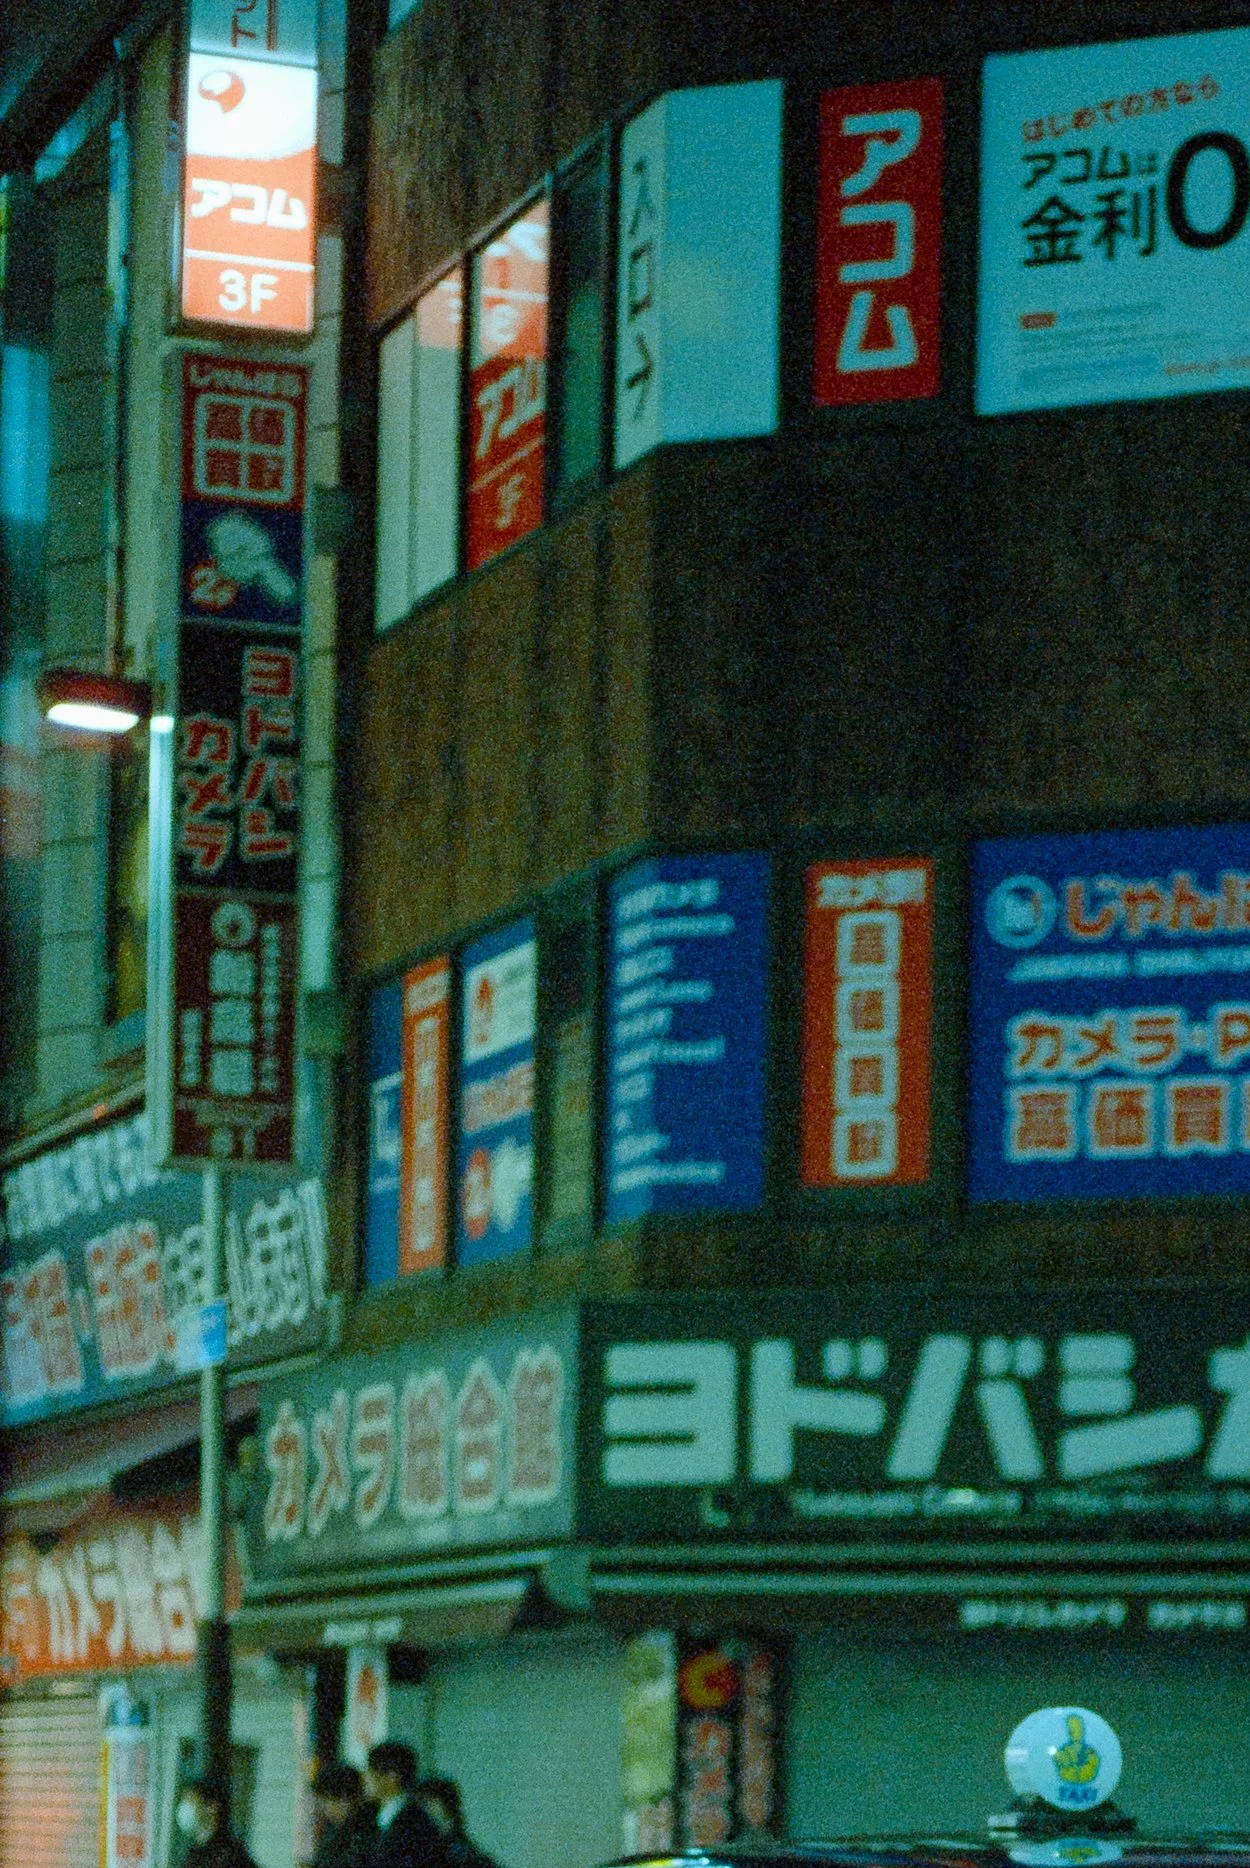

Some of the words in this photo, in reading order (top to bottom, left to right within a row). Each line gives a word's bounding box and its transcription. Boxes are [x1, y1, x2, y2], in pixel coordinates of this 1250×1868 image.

[190, 178, 308, 230] アコム
[836, 107, 924, 373] アコム
[217, 271, 278, 313] 3F
[178, 714, 236, 873] カメラ
[242, 646, 298, 862] ヨドバシ
